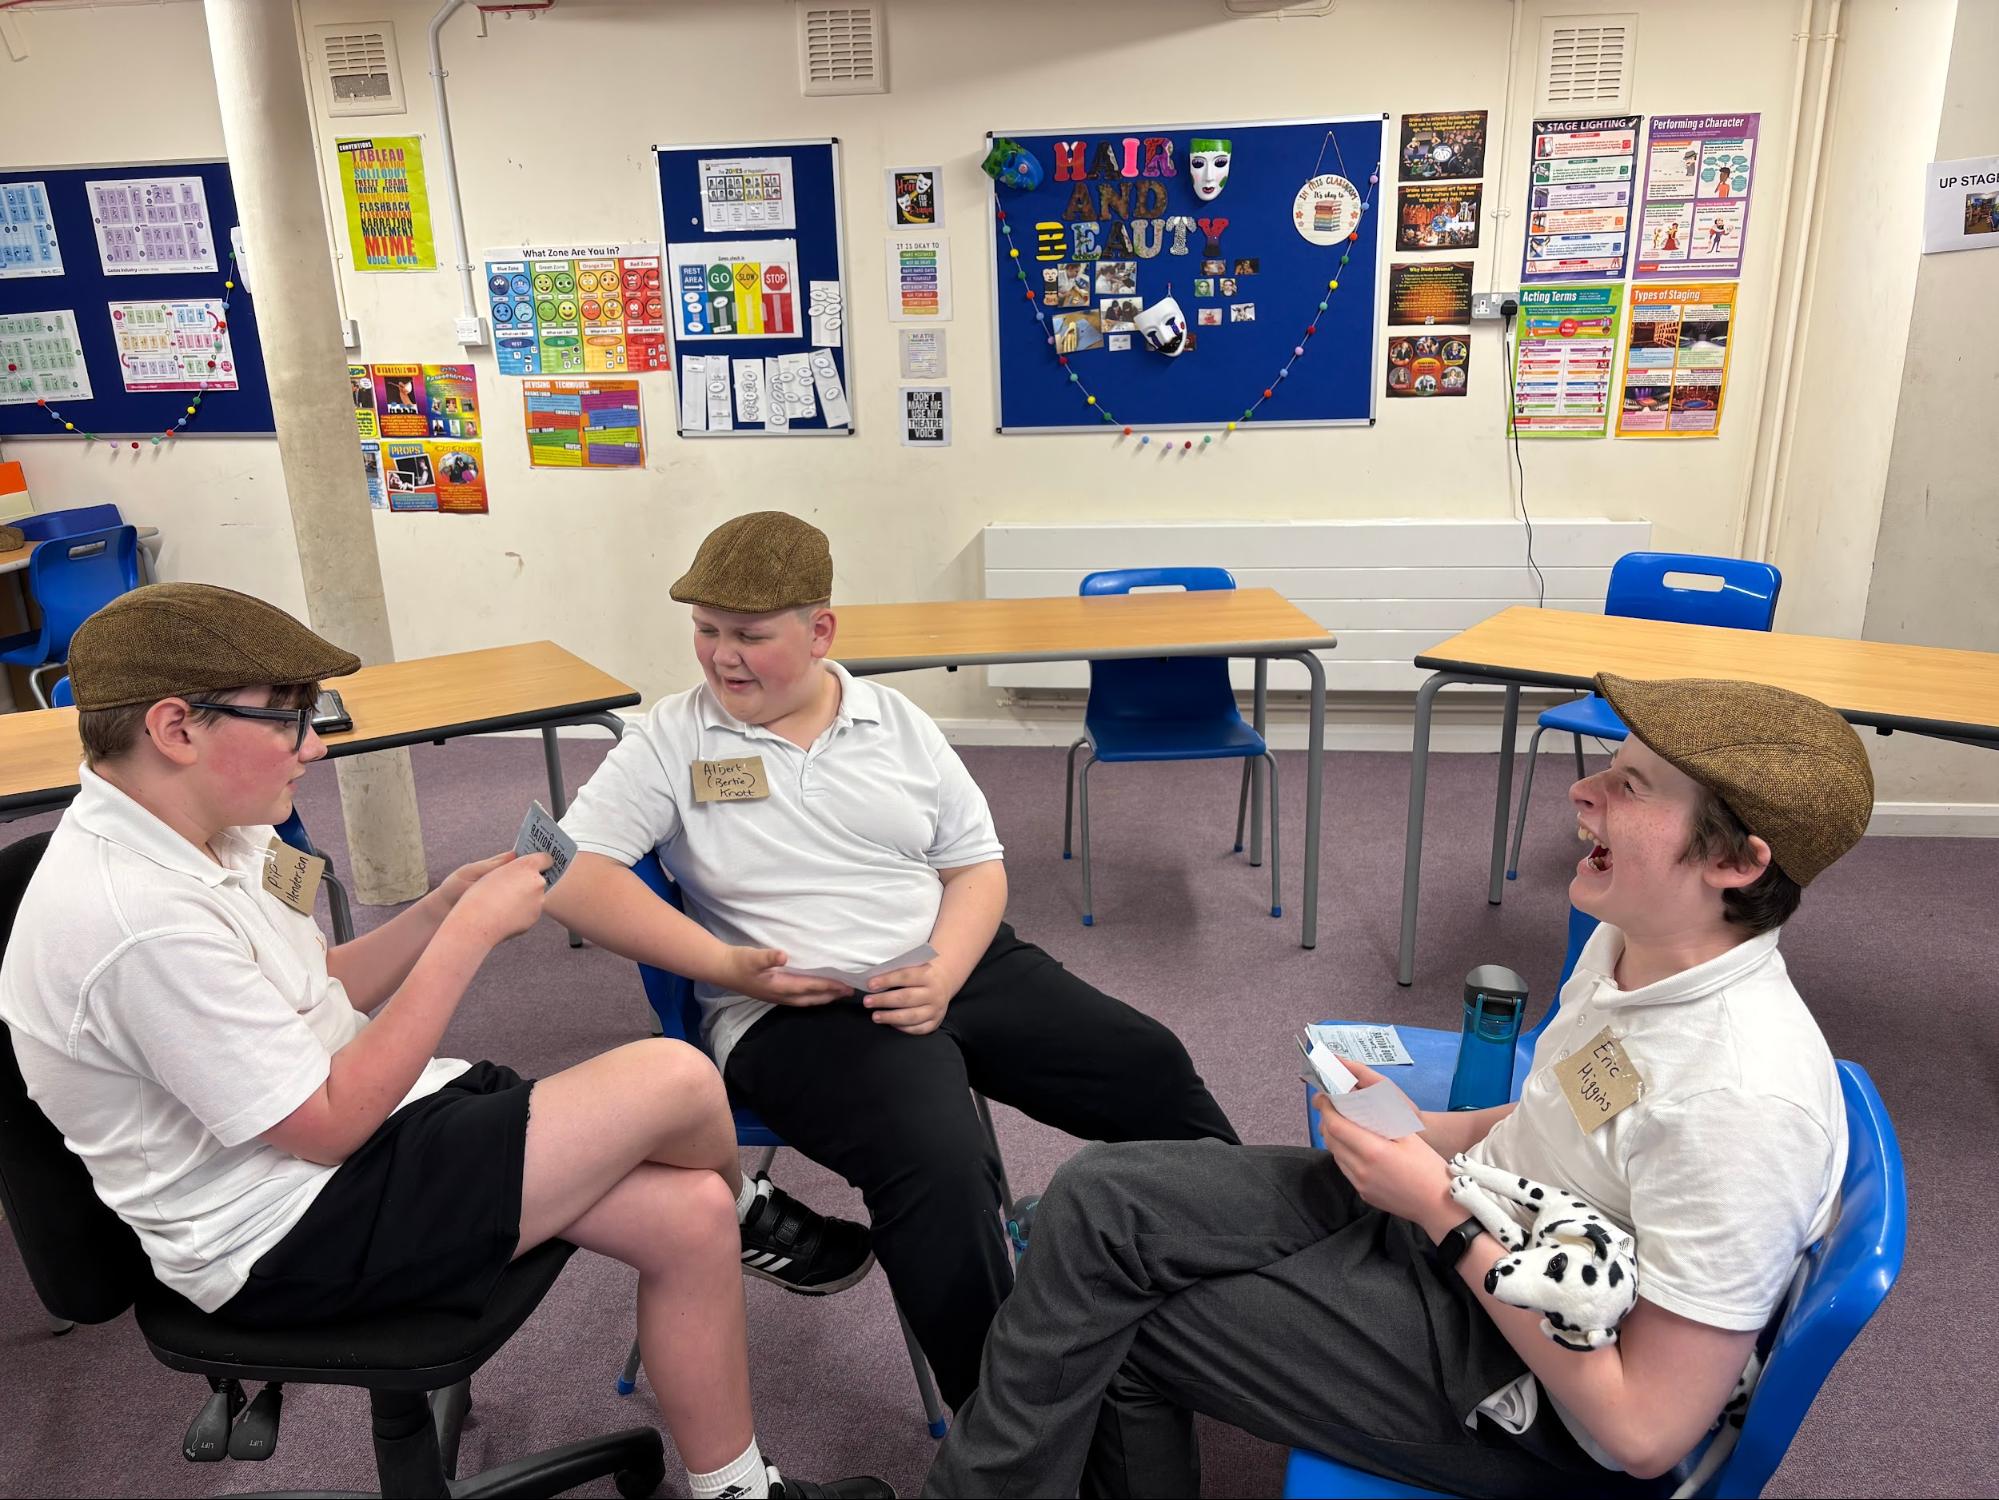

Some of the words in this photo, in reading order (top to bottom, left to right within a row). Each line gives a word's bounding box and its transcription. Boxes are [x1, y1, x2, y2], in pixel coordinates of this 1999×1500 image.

[1547, 122, 1578, 131] STAGE
[1580, 119, 1626, 130] LIGHTING
[1653, 118, 1697, 130] Performing
[1705, 117, 1744, 127] Character
[352, 148, 404, 161] TABLEAU
[1054, 138, 1177, 182] HAIR
[354, 168, 406, 179] SOLILOQUY
[1940, 177, 1957, 188] UP
[1299, 191, 1309, 200] IN
[1326, 177, 1358, 200] CLASSROOM
[1062, 180, 1168, 221] AND
[360, 202, 410, 212] FLASHBACK
[361, 218, 413, 227] NARRATION
[362, 227, 413, 236] MOVEMENT
[1035, 216, 1229, 260] BEAUTY
[364, 235, 416, 256] MIME
[523, 250, 546, 258] What
[548, 249, 569, 257] Zone
[571, 248, 586, 256] Are
[607, 247, 620, 255] In?
[367, 256, 390, 264] VOICE
[396, 256, 418, 264] OVER
[684, 276, 703, 284] AREA
[711, 273, 729, 283] GO
[766, 273, 786, 284] STOP
[1522, 291, 1550, 304] Acting
[1552, 291, 1577, 302] Terms
[1634, 290, 1657, 302] Types
[1659, 290, 1667, 300] of
[1669, 290, 1700, 301] Staging
[524, 381, 551, 389] DEVISING
[908, 401, 929, 409] MAKE
[930, 400, 942, 409] ME
[912, 410, 926, 418] USE
[927, 409, 939, 418] MY
[910, 419, 942, 427] THEATRE
[915, 429, 936, 438] VOICE
[391, 445, 420, 455] PROPS
[720, 789, 755, 797] Knott
[531, 824, 552, 852] RATION
[551, 846, 567, 870] BOOK
[285, 856, 309, 903] Henderson
[1593, 1041, 1619, 1078] Eric
[1577, 1062, 1611, 1112] Higgins
